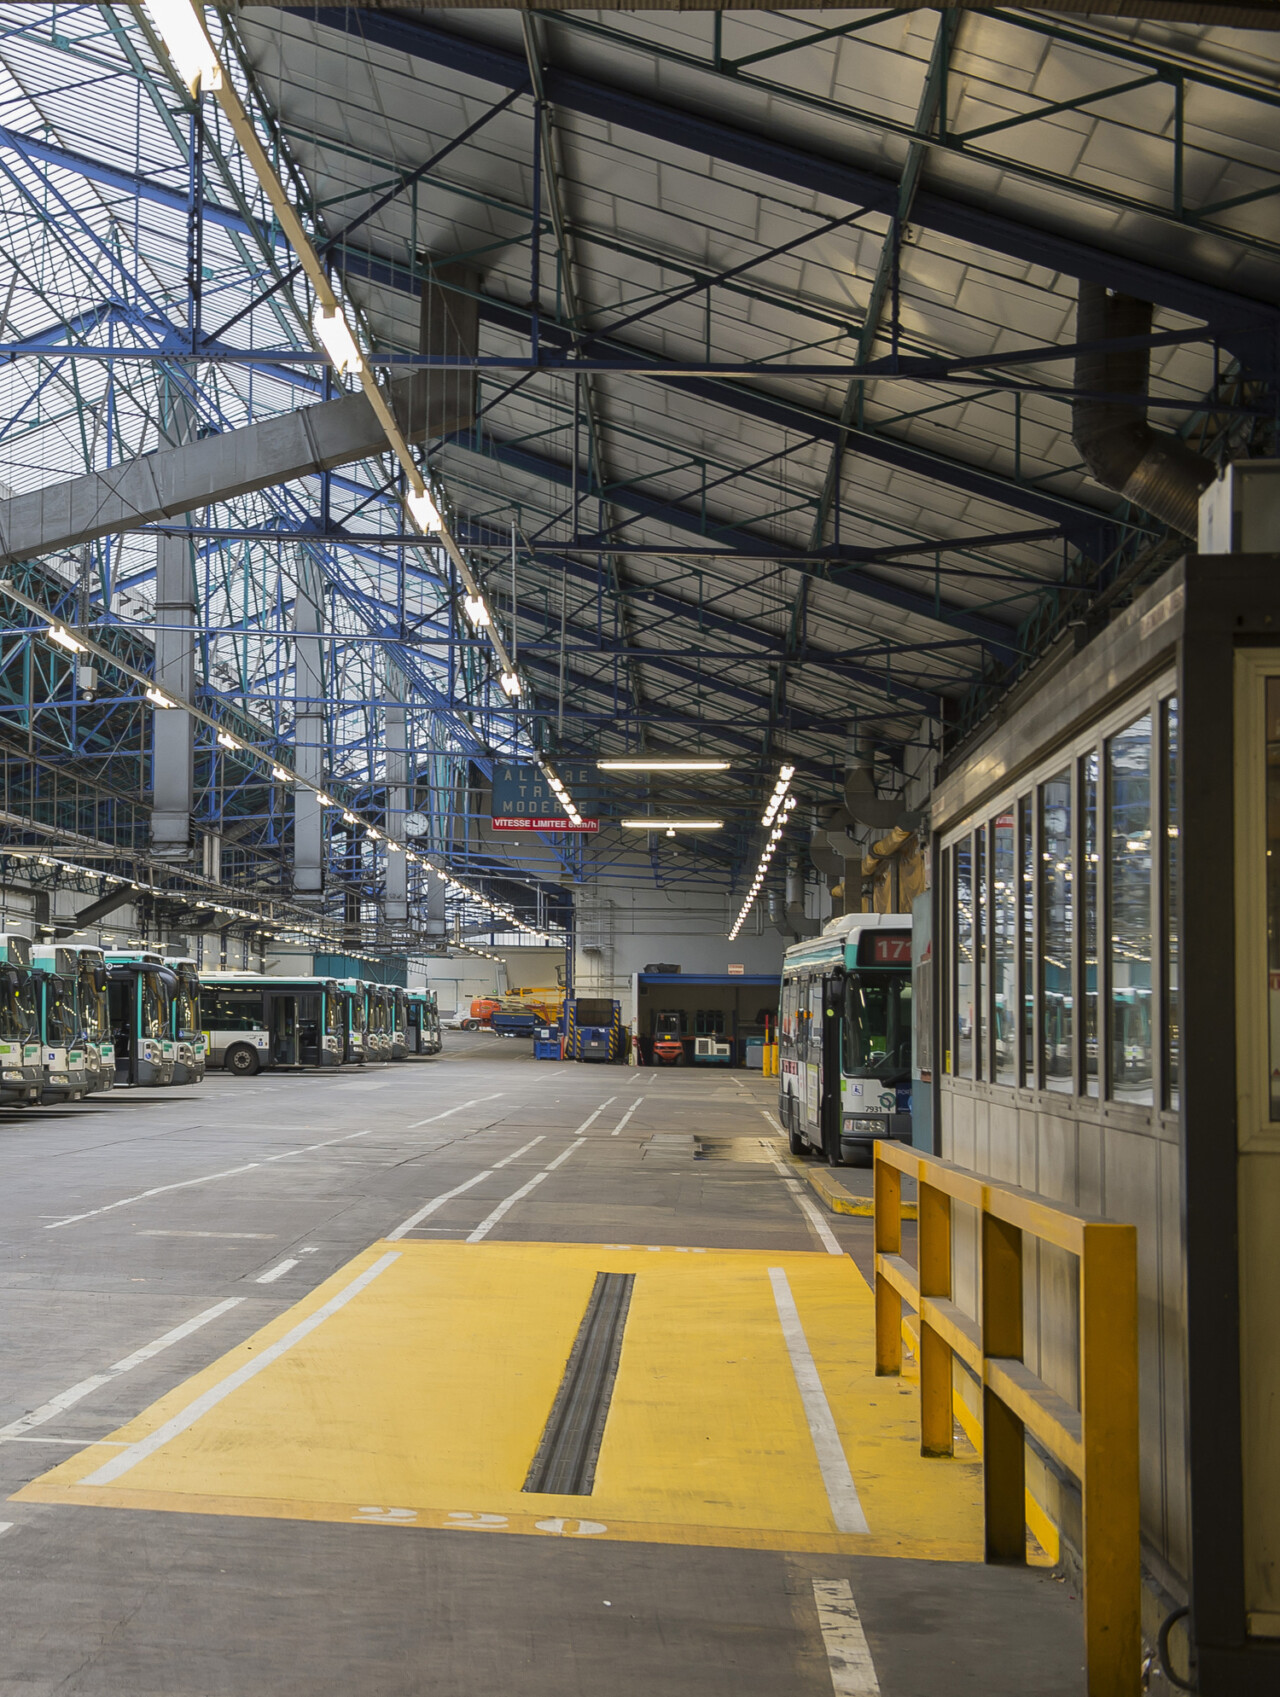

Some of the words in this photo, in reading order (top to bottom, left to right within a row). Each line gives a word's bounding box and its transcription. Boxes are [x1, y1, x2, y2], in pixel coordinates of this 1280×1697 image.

[504, 769, 588, 783] ALLRE
[494, 819, 531, 827] VITESSE
[532, 820, 567, 828] LIMITEE
[351, 1506, 578, 1536] 220
